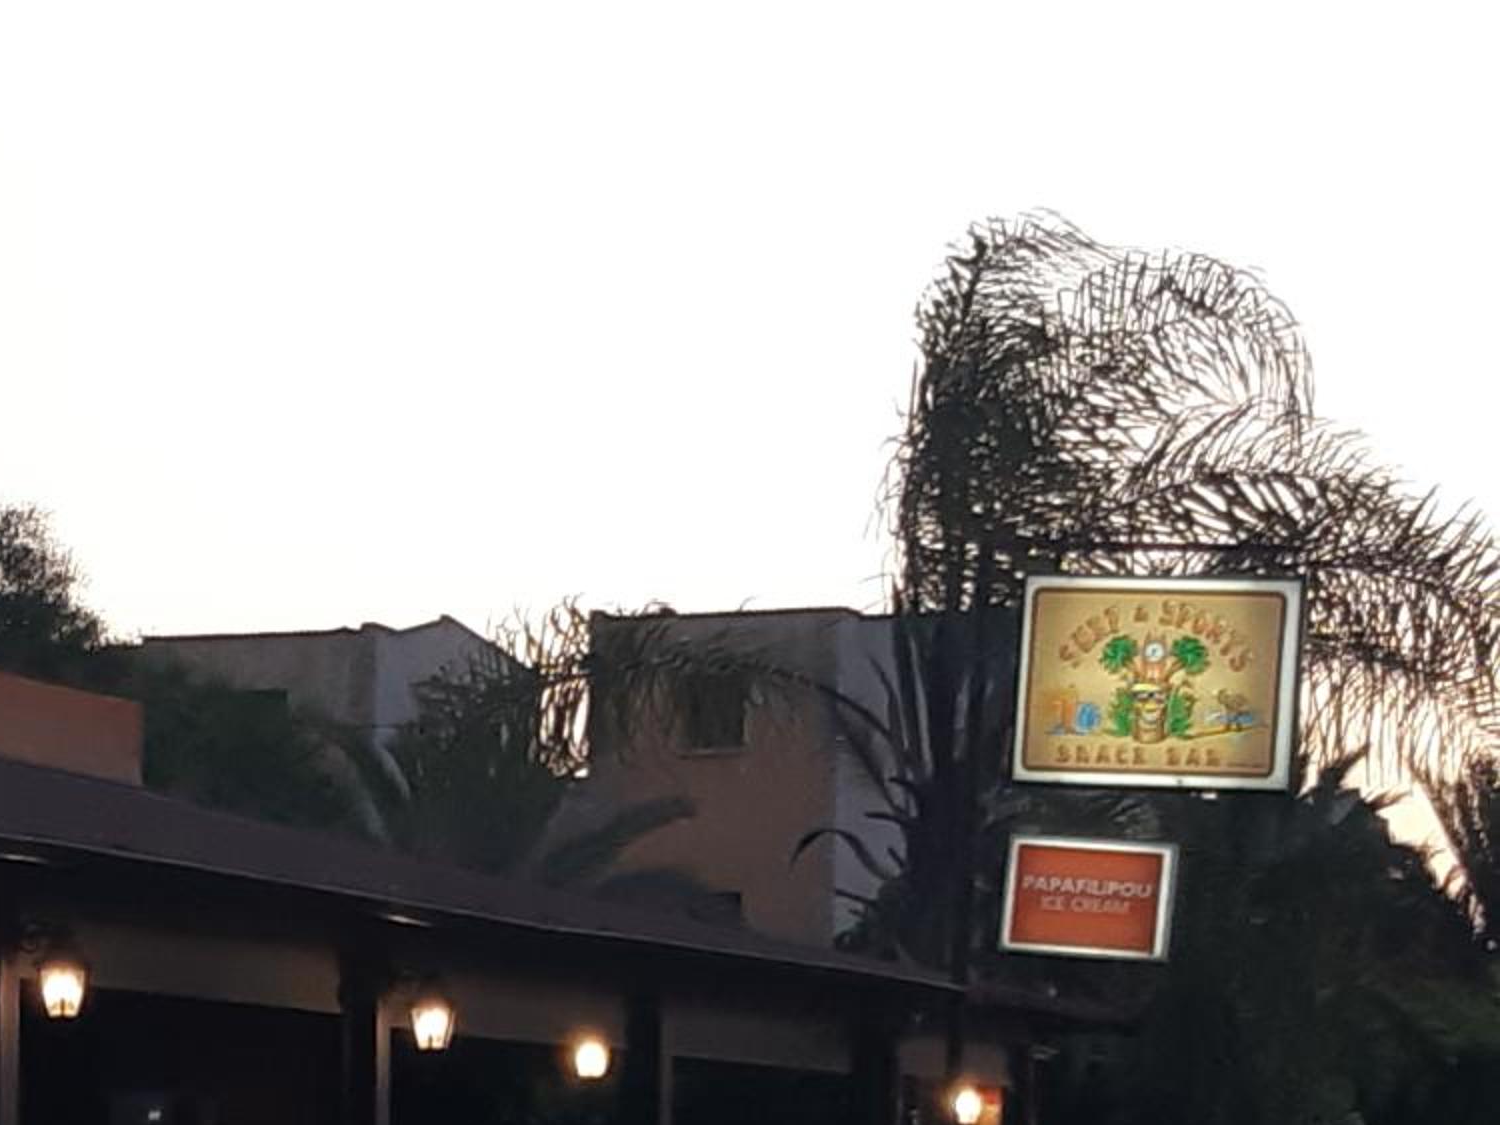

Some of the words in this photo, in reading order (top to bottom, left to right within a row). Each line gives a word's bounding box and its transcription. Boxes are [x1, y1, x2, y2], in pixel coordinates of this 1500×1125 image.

[1055, 744, 1147, 766] SNACK
[1165, 745, 1222, 767] BAR
[1021, 874, 1153, 898] PAPAFILIPOU
[1041, 895, 1065, 911] ICE
[1070, 896, 1131, 914] CREAM
